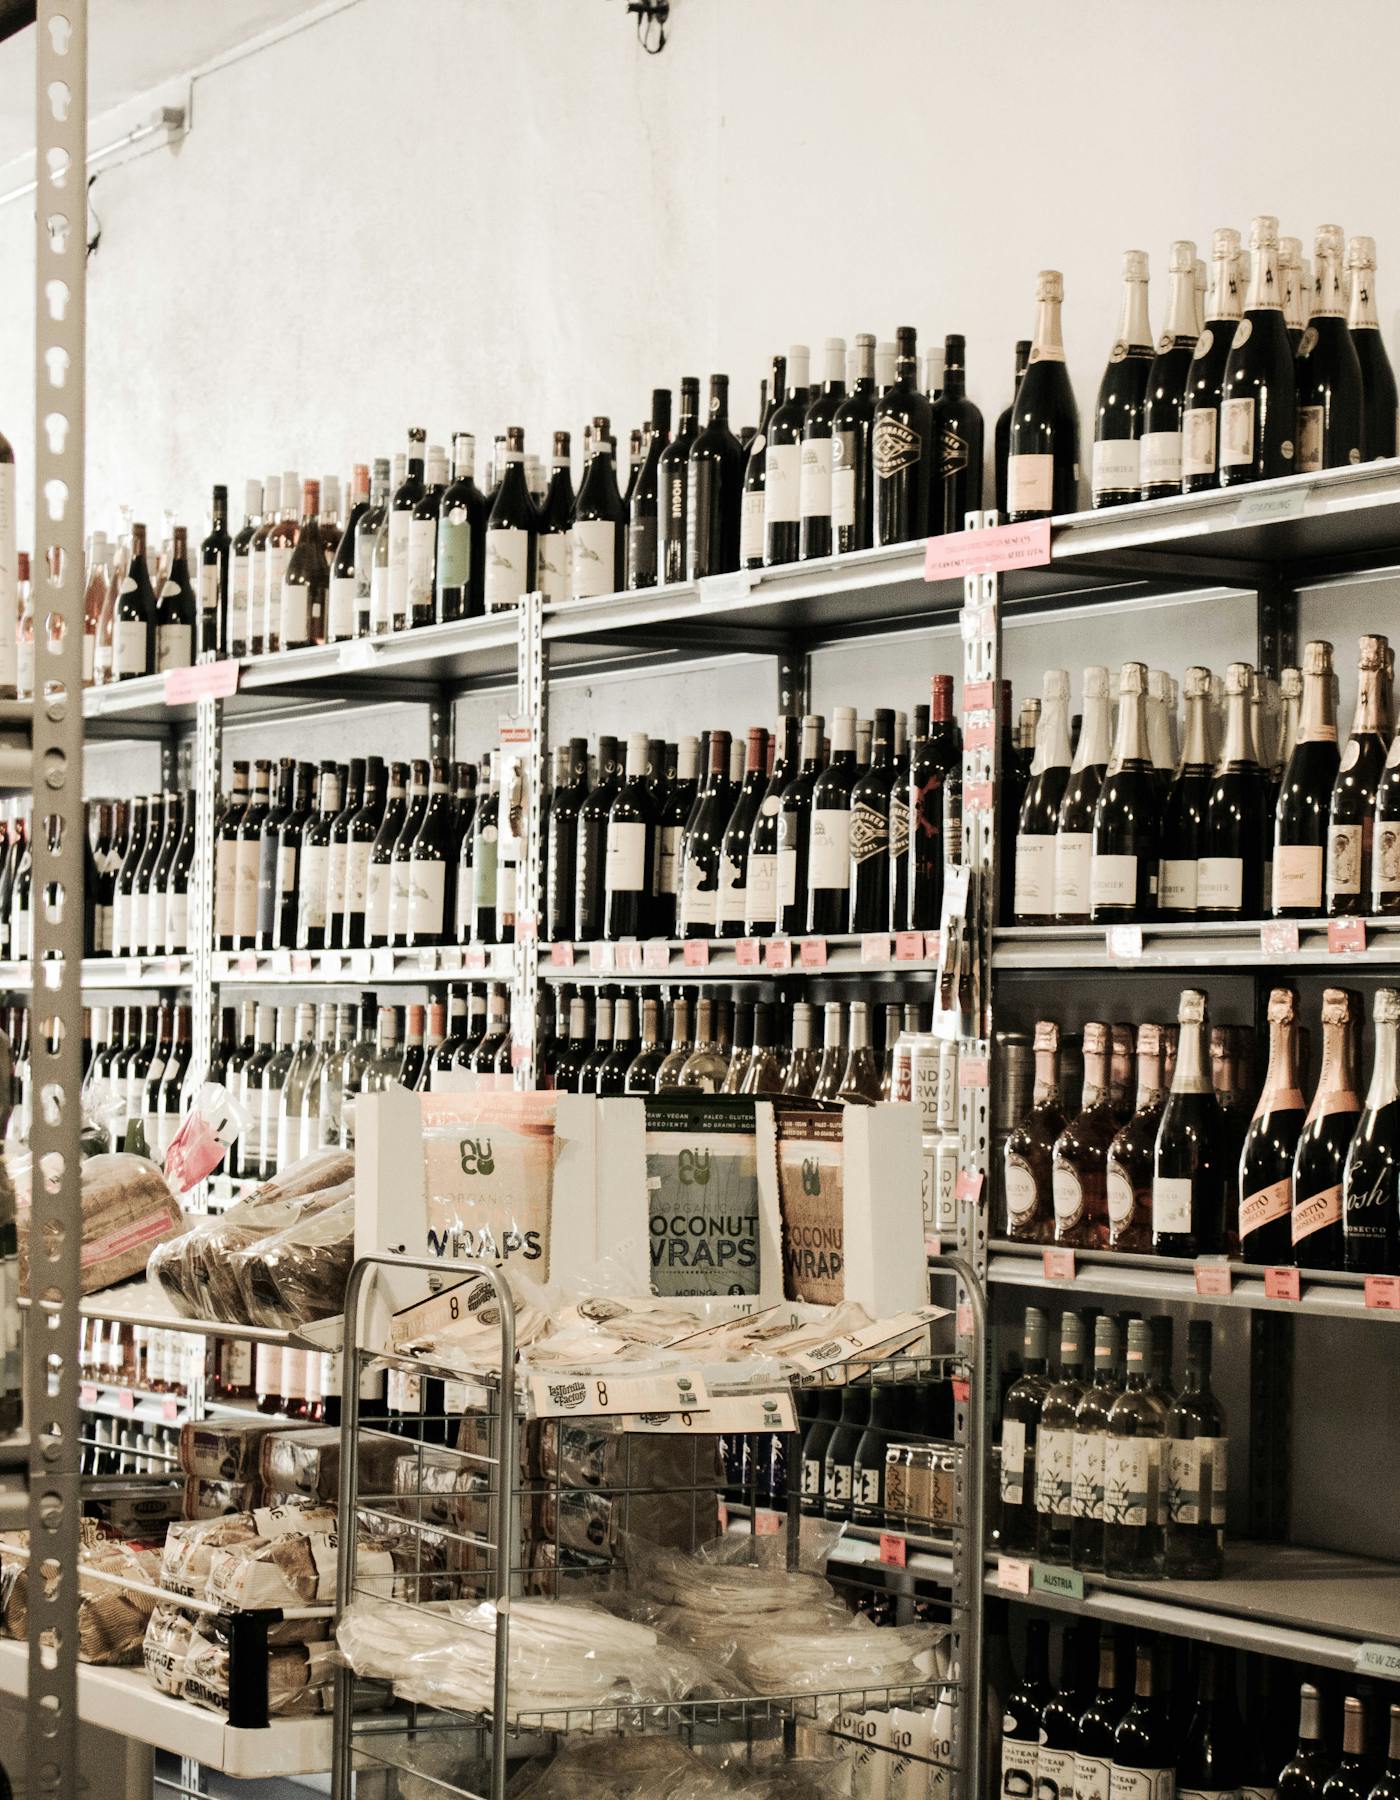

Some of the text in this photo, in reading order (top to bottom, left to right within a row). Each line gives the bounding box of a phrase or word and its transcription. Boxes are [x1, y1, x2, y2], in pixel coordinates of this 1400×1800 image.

[672, 479, 682, 518] HOGUE
[649, 1215, 759, 1237] OCONUT
[791, 1226, 843, 1250] OCONU
[791, 1248, 845, 1280] RAP
[450, 1296, 459, 1320] 8
[843, 1335, 863, 1347] 8
[553, 1390, 586, 1406] Factory
[556, 1381, 586, 1397] Tortilla
[597, 1381, 608, 1406] 8
[1043, 1574, 1073, 1591] AUSTRIA
[1364, 1651, 1384, 1665] NEW
